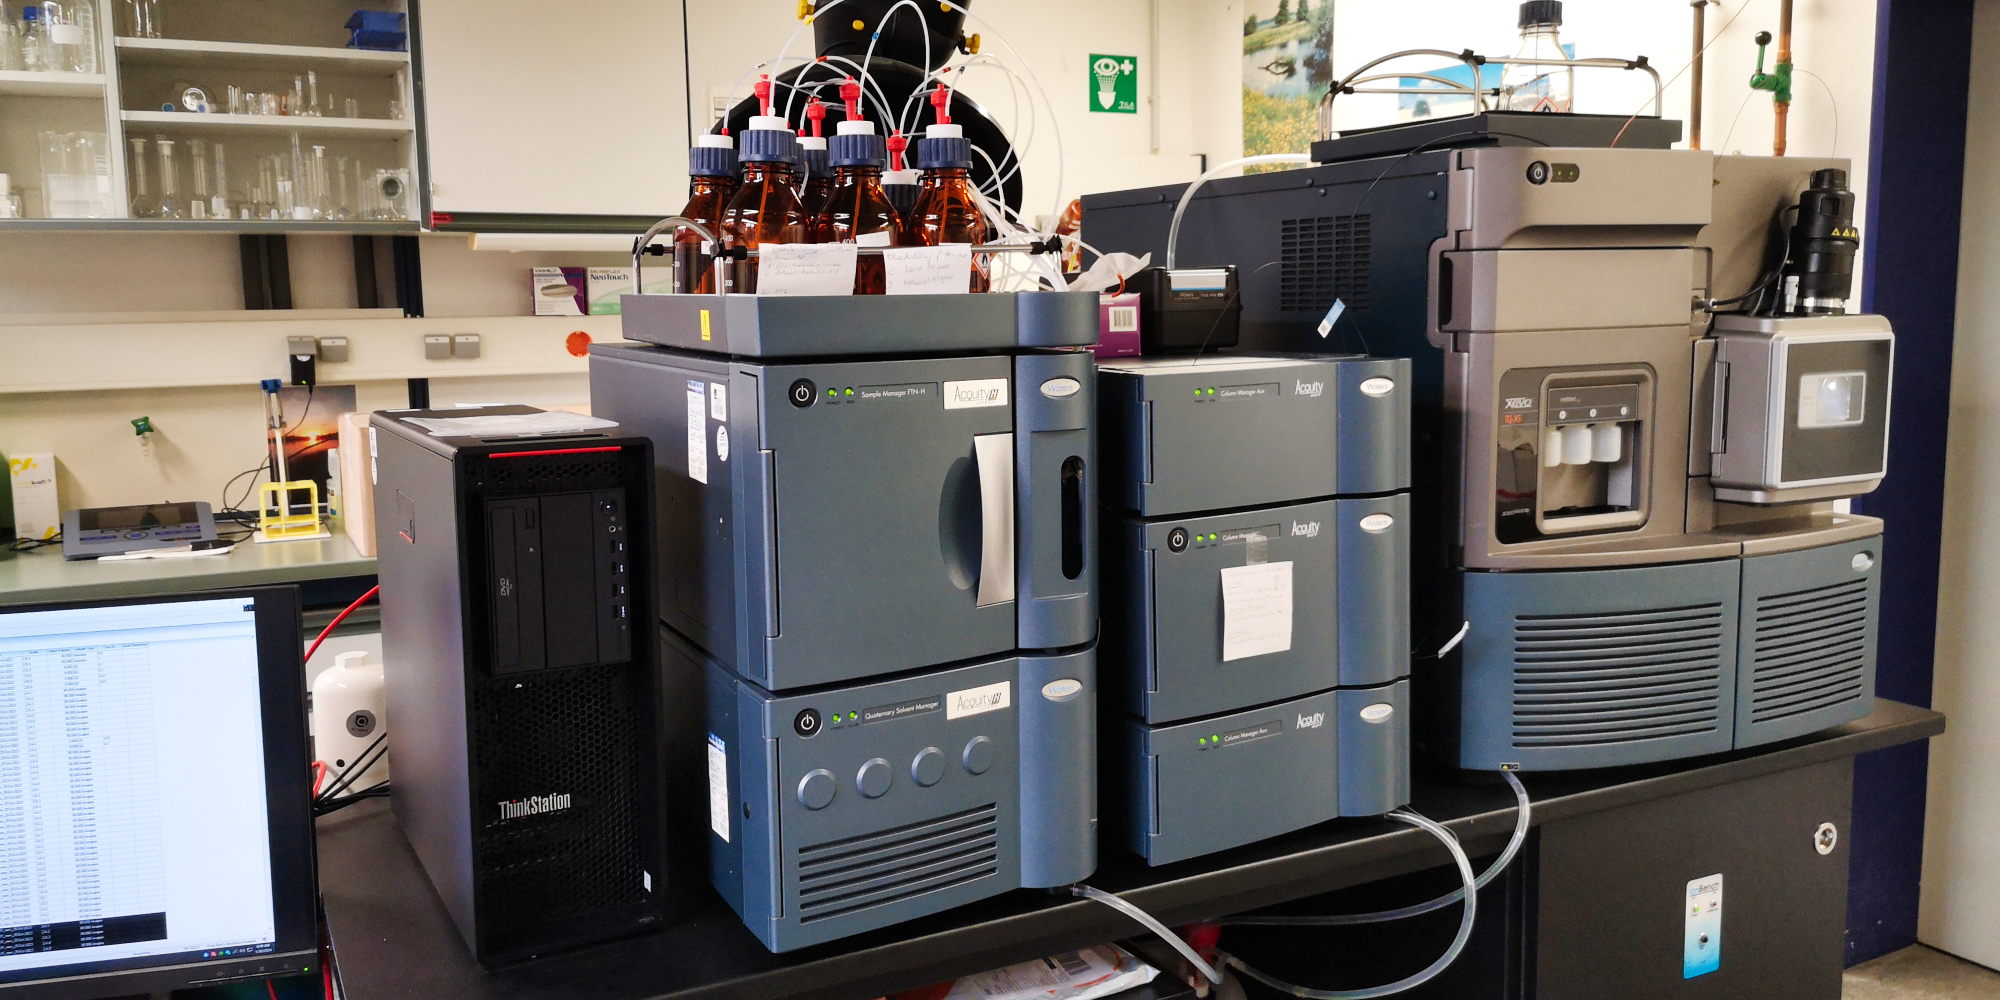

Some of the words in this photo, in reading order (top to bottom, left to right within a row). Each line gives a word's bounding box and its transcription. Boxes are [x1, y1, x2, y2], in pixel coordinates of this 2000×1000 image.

[590, 273, 629, 281] NeoTouch
[1047, 383, 1074, 392] Waters
[1295, 379, 1324, 397] Acquity
[1366, 382, 1389, 391] Waters
[861, 390, 882, 399] Sample
[882, 389, 907, 399] Manager
[907, 387, 926, 396] FTN-H
[953, 385, 990, 404] Acquity
[1220, 389, 1237, 397] Column
[1237, 389, 1256, 397] Manager
[1504, 397, 1533, 410] Xevo
[1291, 520, 1320, 537] Acquity
[1365, 519, 1388, 527] Waters
[1222, 533, 1239, 542] Column
[1049, 683, 1075, 694] Waters
[956, 694, 993, 711] Acquity
[864, 707, 895, 721] Quaternary
[895, 704, 915, 716] Solvent
[915, 700, 939, 714] Manager
[1366, 708, 1387, 717] Waters
[1297, 713, 1324, 729] Acquity
[1224, 734, 1240, 742] Column
[1240, 731, 1258, 740] Manager
[498, 792, 571, 820] ThinkStation
[1689, 882, 1719, 894] ionBench
